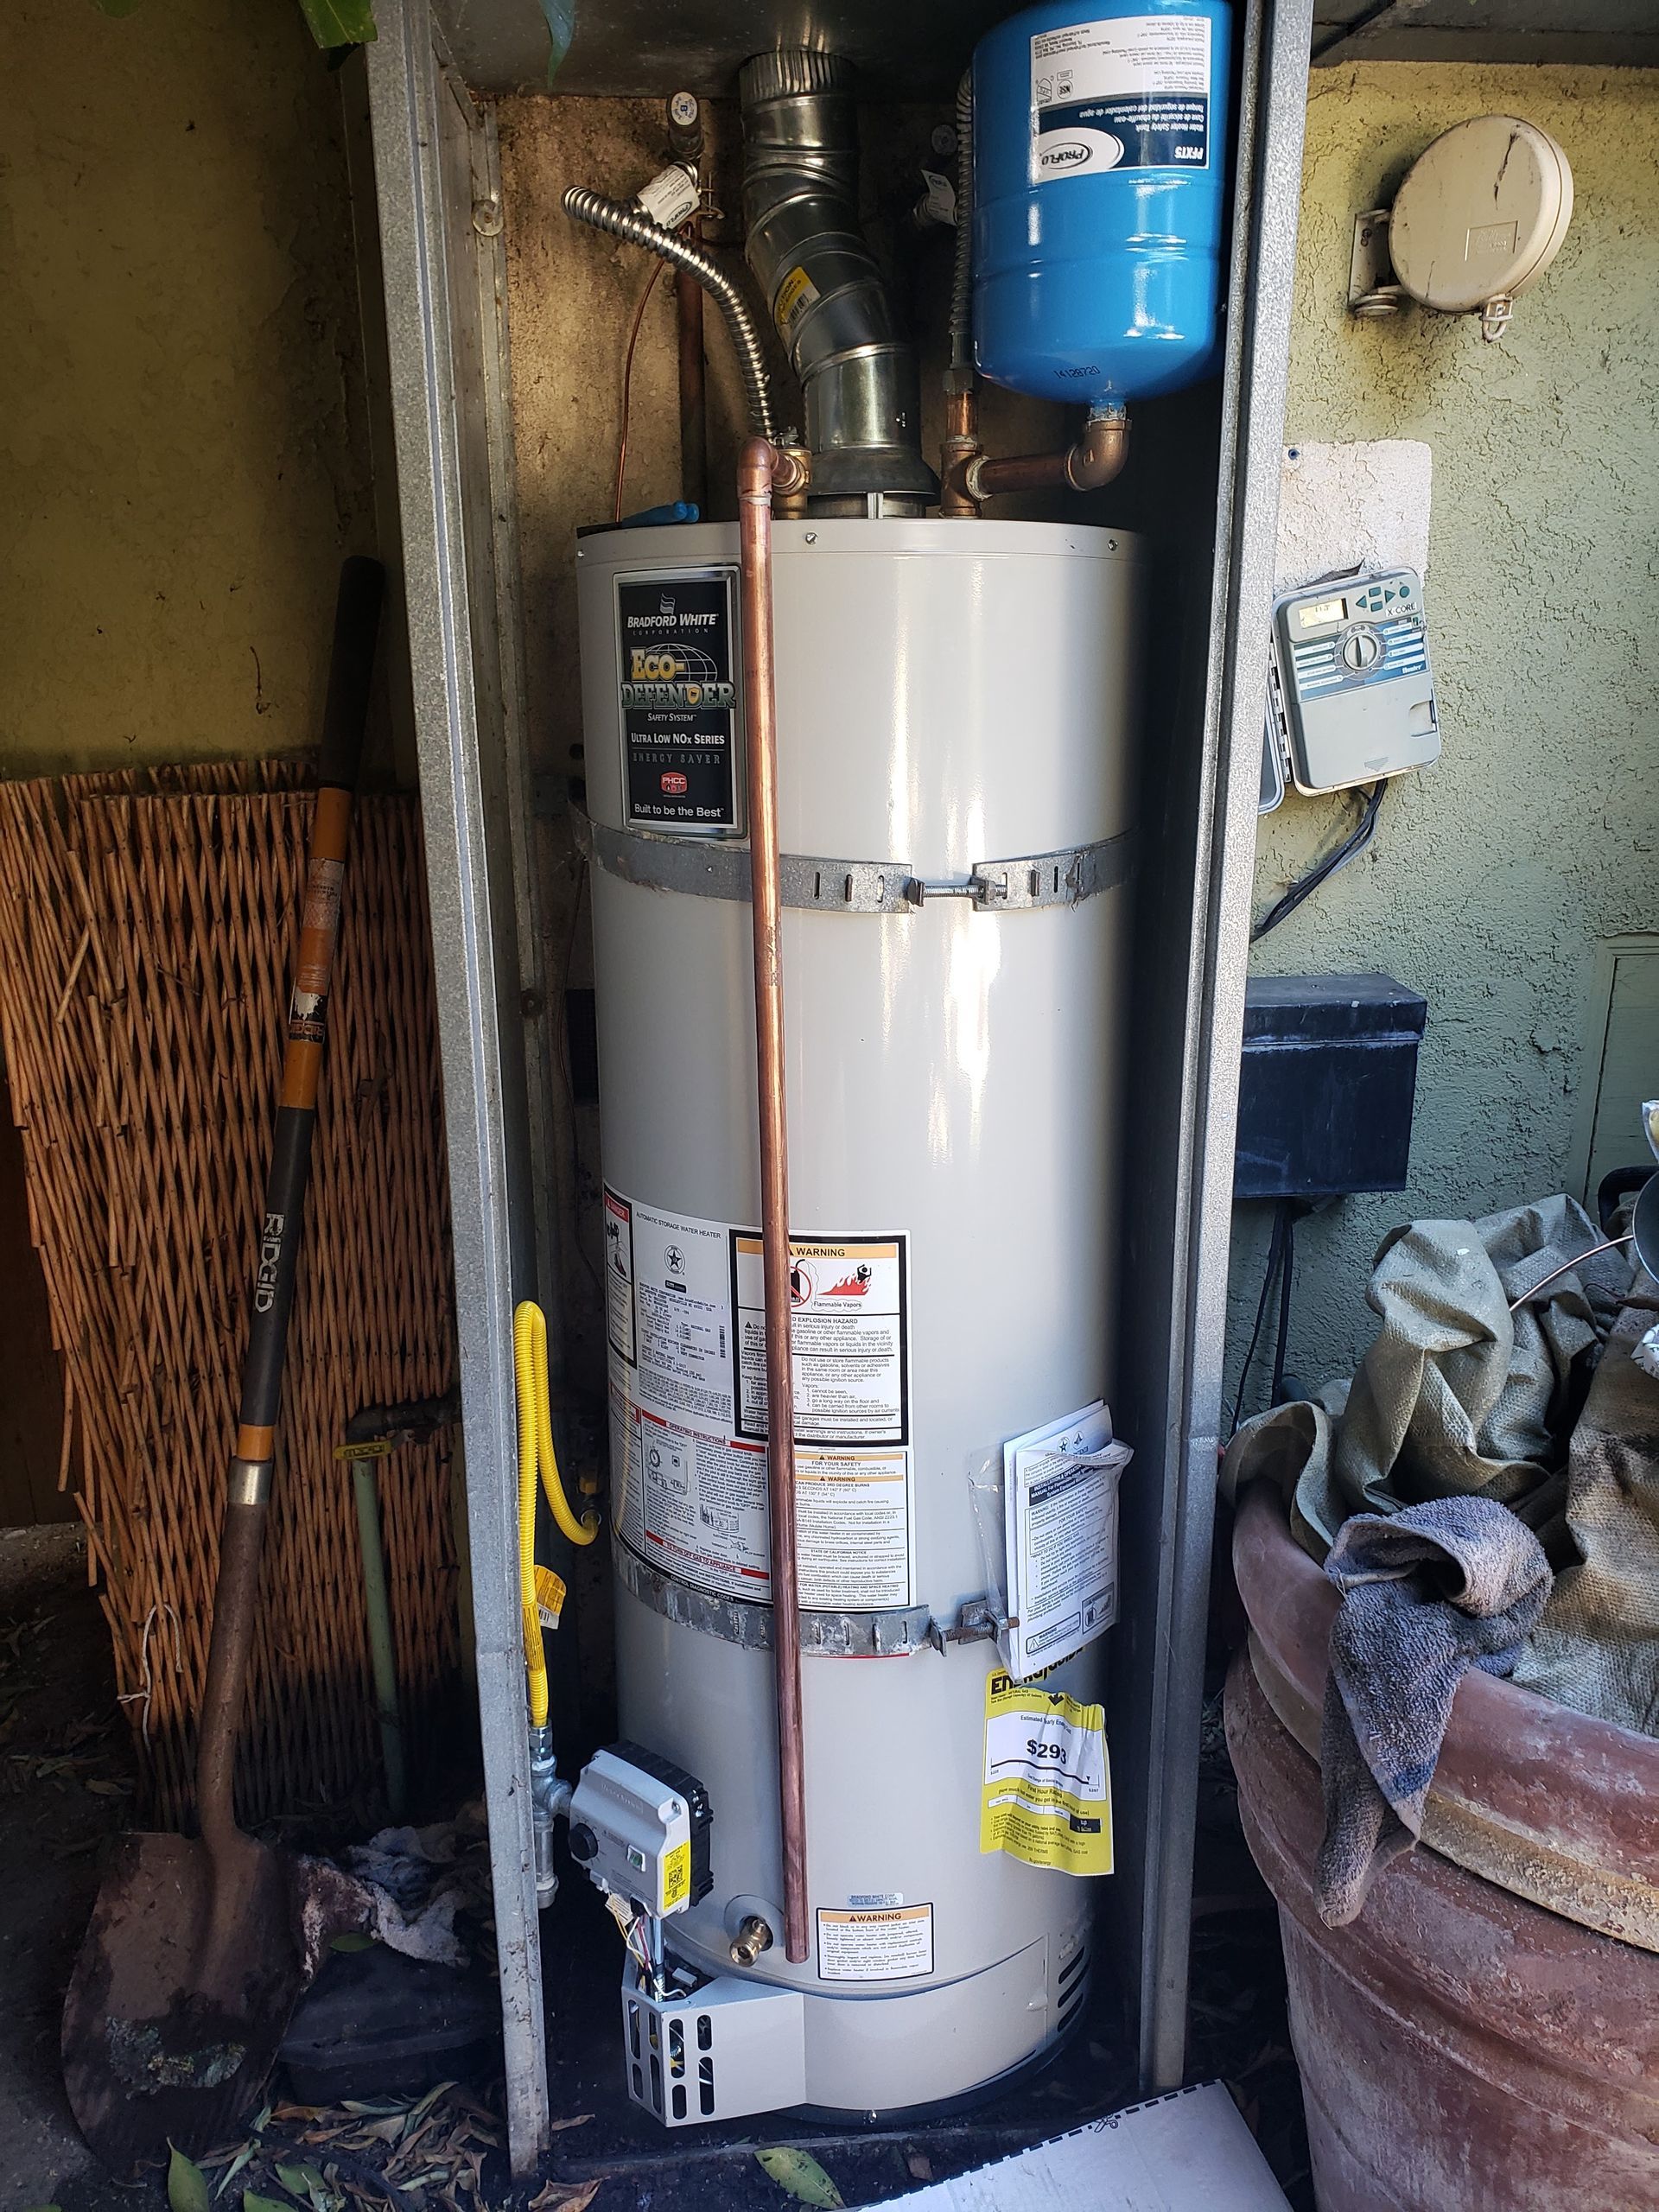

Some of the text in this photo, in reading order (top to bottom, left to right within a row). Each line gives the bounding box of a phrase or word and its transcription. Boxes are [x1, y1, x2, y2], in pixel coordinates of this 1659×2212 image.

[1135, 124, 1150, 132] Tank
[1151, 123, 1170, 131] Safety
[1042, 149, 1083, 165] PROFLO
[628, 613, 715, 627] BRADFORD WHITE
[1402, 664, 1421, 674] Hunter
[621, 683, 735, 709] DEFENDER
[632, 733, 724, 744] ULTRA LOW NOx SERIES
[633, 753, 720, 764] ENERGY SAVER
[635, 804, 721, 817] Built to be the Best
[637, 1211, 721, 1238] AUTOMATIC STORAGE WATER HEATER
[797, 1248, 845, 1256] WARNING
[254, 1213, 284, 1313] RIDGID
[670, 1422, 725, 1444] OPERATING INSTRUCTIONS
[671, 1574, 734, 1602] CONTROL DIAGNOSTIC CODES
[1027, 1738, 1066, 1764] $293
[857, 1913, 901, 1922] WARNING
